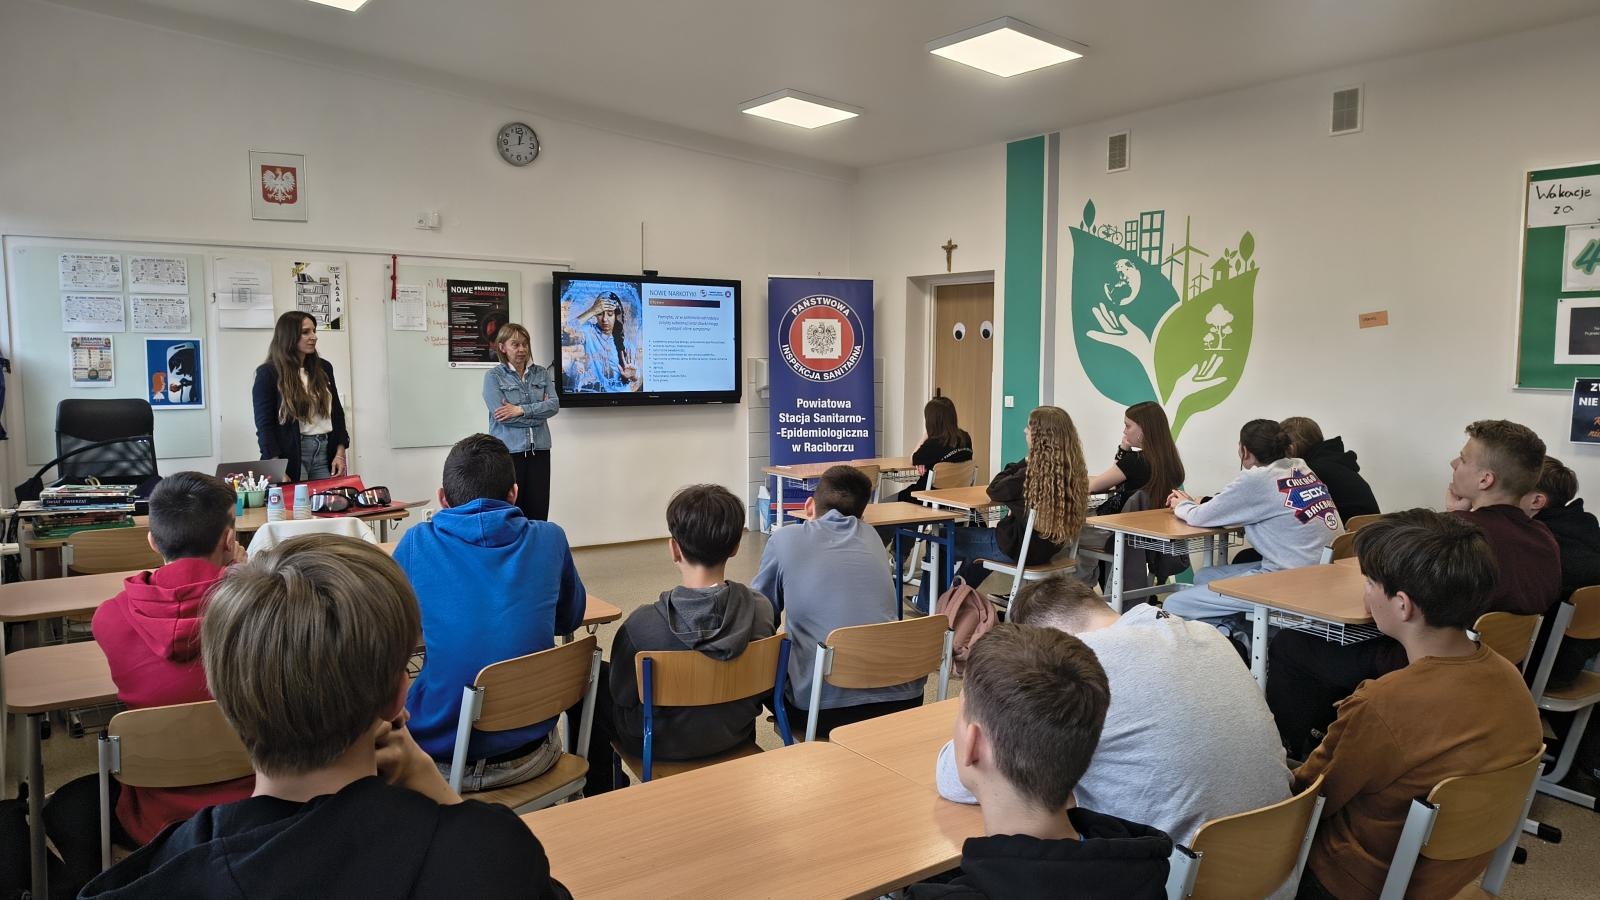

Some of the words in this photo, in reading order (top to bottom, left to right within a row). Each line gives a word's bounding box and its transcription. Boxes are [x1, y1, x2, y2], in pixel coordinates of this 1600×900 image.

[1536, 184, 1592, 200] Wakacje
[1553, 205, 1574, 215] za
[450, 286, 474, 294] NOWE
[649, 289, 667, 297] NOWE
[668, 290, 697, 298] NARKOTYKI
[791, 297, 850, 317] PAŃSTWOWA
[781, 344, 821, 380] INSPEKCJA
[823, 345, 862, 380] SANITARNA
[796, 398, 852, 409] Powiatowa
[1578, 397, 1599, 406] NIE
[778, 413, 811, 425] Stacja
[813, 413, 866, 423] Sanitarno-
[776, 427, 869, 440] -Epidemiologiczna
[791, 444, 802, 452] w
[804, 442, 855, 453] Raciborzu
[1286, 474, 1317, 487] CHICAGO
[1299, 486, 1326, 502] SOX
